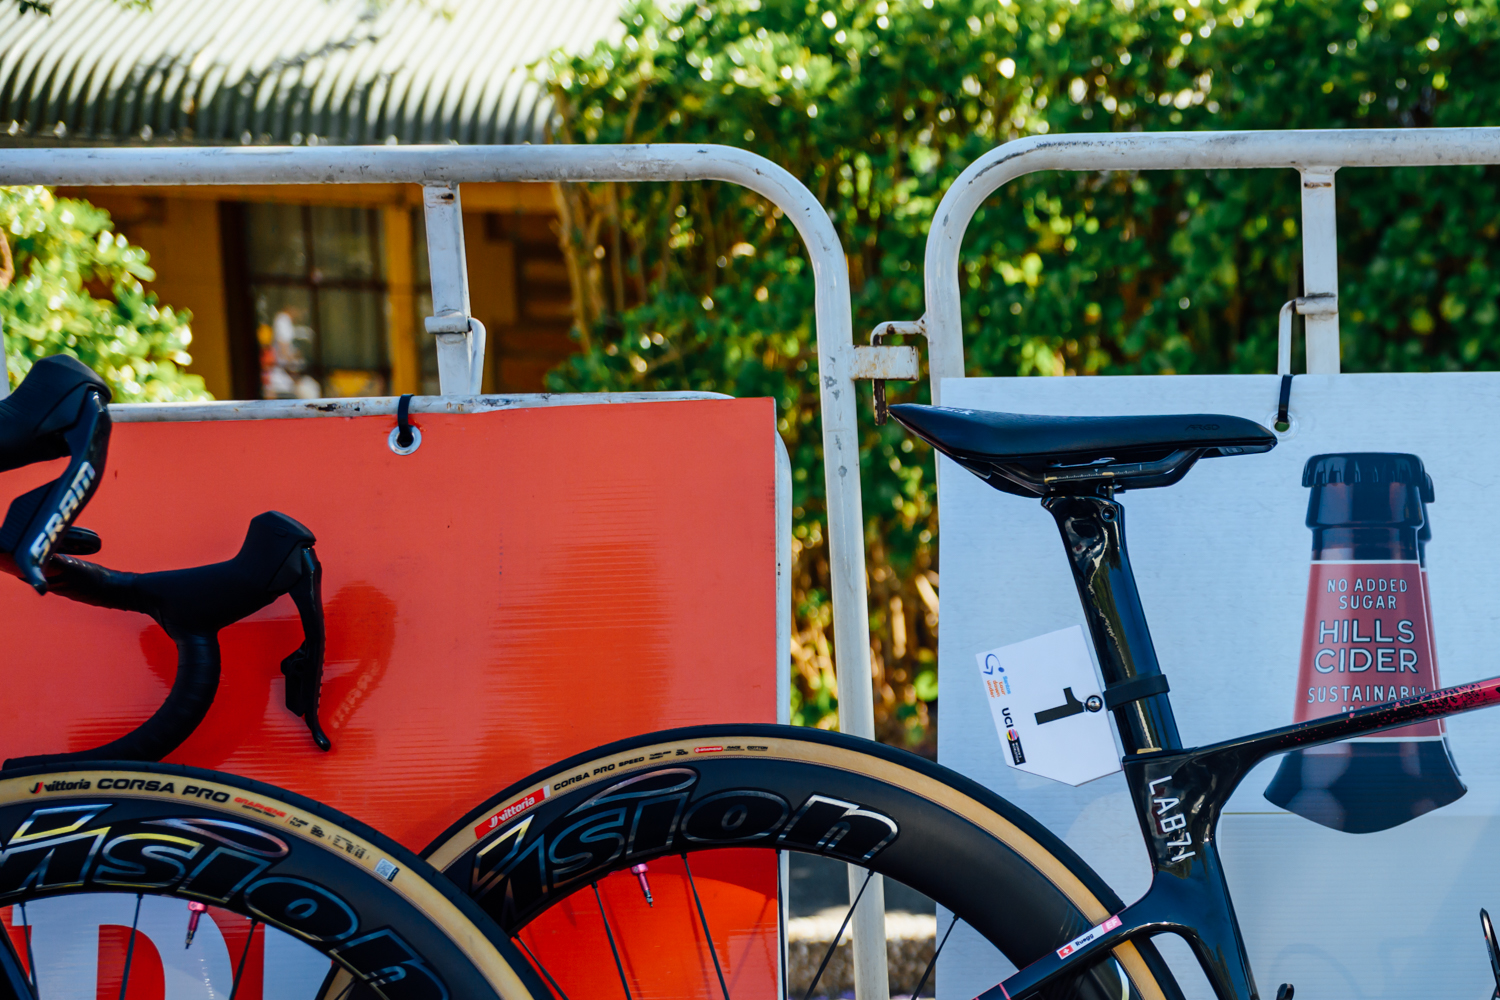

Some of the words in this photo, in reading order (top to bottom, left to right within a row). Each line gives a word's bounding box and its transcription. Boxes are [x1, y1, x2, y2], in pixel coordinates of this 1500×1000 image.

[29, 461, 96, 565] SRAM
[1327, 578, 1348, 593] NO
[1354, 578, 1408, 593] ADDED
[1339, 594, 1397, 610] SUGAR
[1319, 619, 1415, 644] HILLS
[1314, 648, 1419, 674] CIDER
[1001, 706, 1014, 729] UCI
[1034, 686, 1087, 726] 1
[44, 778, 91, 792] vittoria
[96, 778, 175, 794] CORSA
[182, 785, 231, 803] PRO
[498, 796, 535, 822] vittoria
[553, 772, 591, 791] CORSA
[593, 763, 616, 775] PRO
[618, 756, 645, 768] SPEED
[1105, 918, 1118, 930] EF
